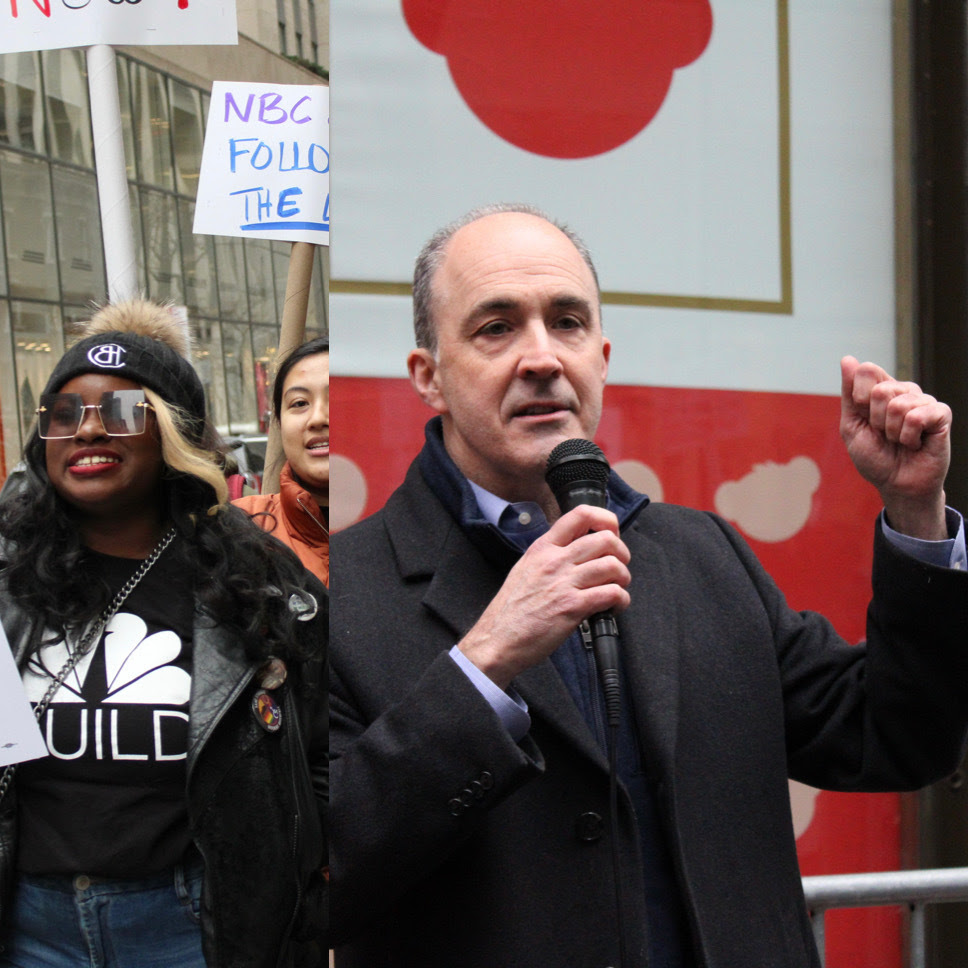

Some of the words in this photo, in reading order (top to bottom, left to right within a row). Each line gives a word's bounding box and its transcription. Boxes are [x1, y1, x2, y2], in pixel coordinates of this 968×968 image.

[224, 92, 312, 124] NBC
[229, 187, 303, 222] THE
[46, 708, 190, 761] UILD
